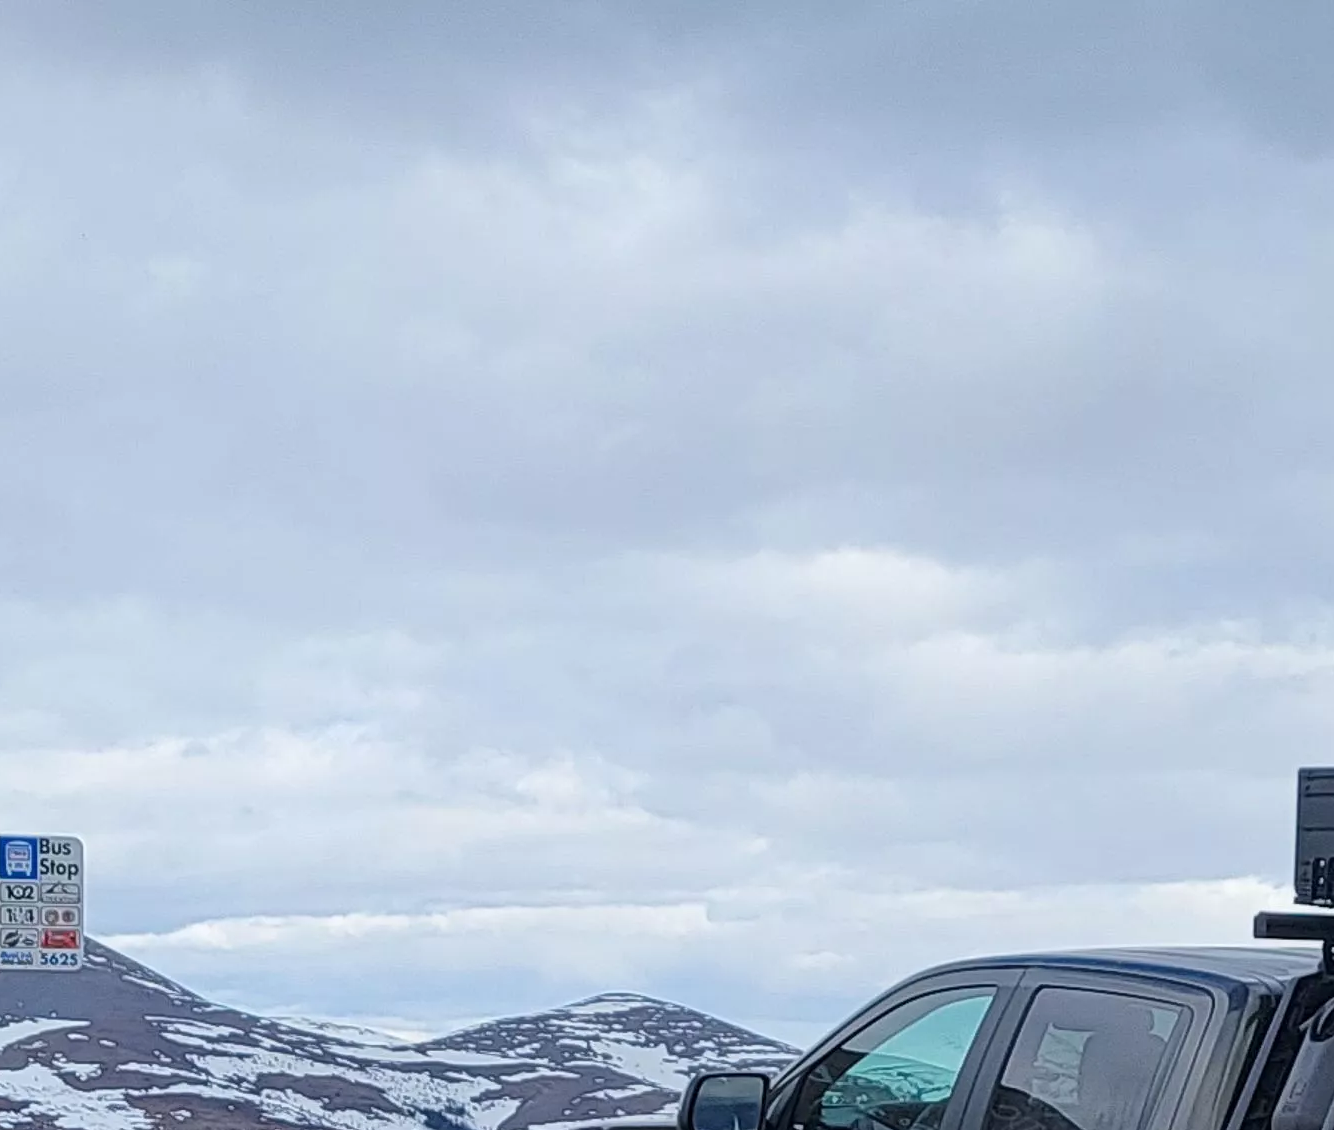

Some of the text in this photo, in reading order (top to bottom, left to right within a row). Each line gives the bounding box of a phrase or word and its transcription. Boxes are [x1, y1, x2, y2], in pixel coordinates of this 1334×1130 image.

[39, 837, 72, 856] Bus
[39, 857, 79, 881] Stop
[39, 952, 79, 966] 5625
